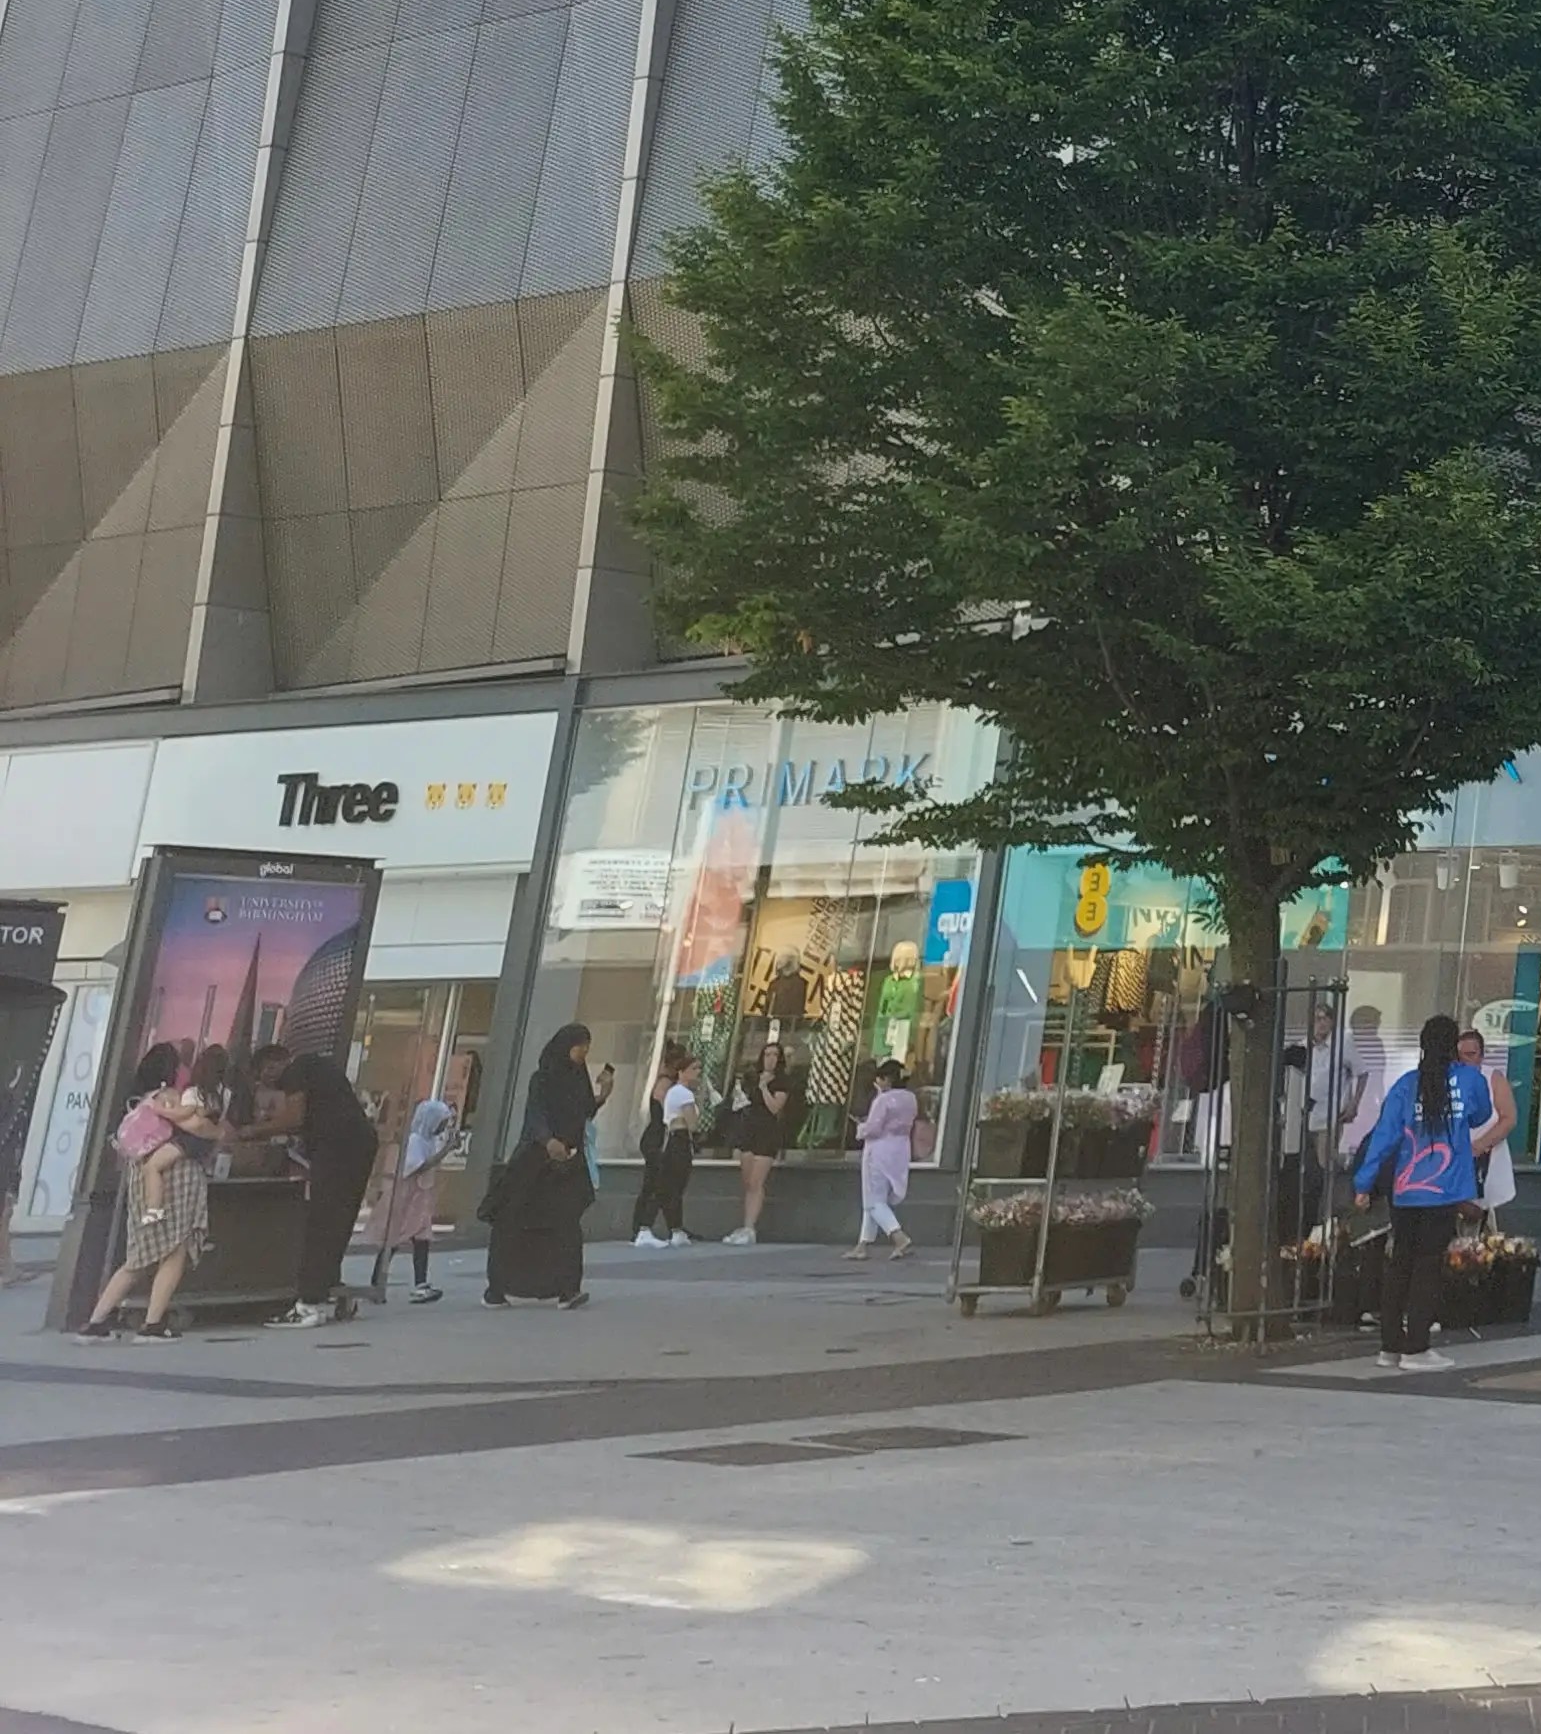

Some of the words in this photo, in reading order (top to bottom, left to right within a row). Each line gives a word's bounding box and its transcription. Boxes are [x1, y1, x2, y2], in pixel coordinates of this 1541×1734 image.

[277, 772, 399, 827] Three
[259, 862, 294, 877] global
[241, 896, 312, 909] UNIVERSITY
[239, 908, 324, 923] BIRMINGHAM
[0, 926, 44, 945] TOR
